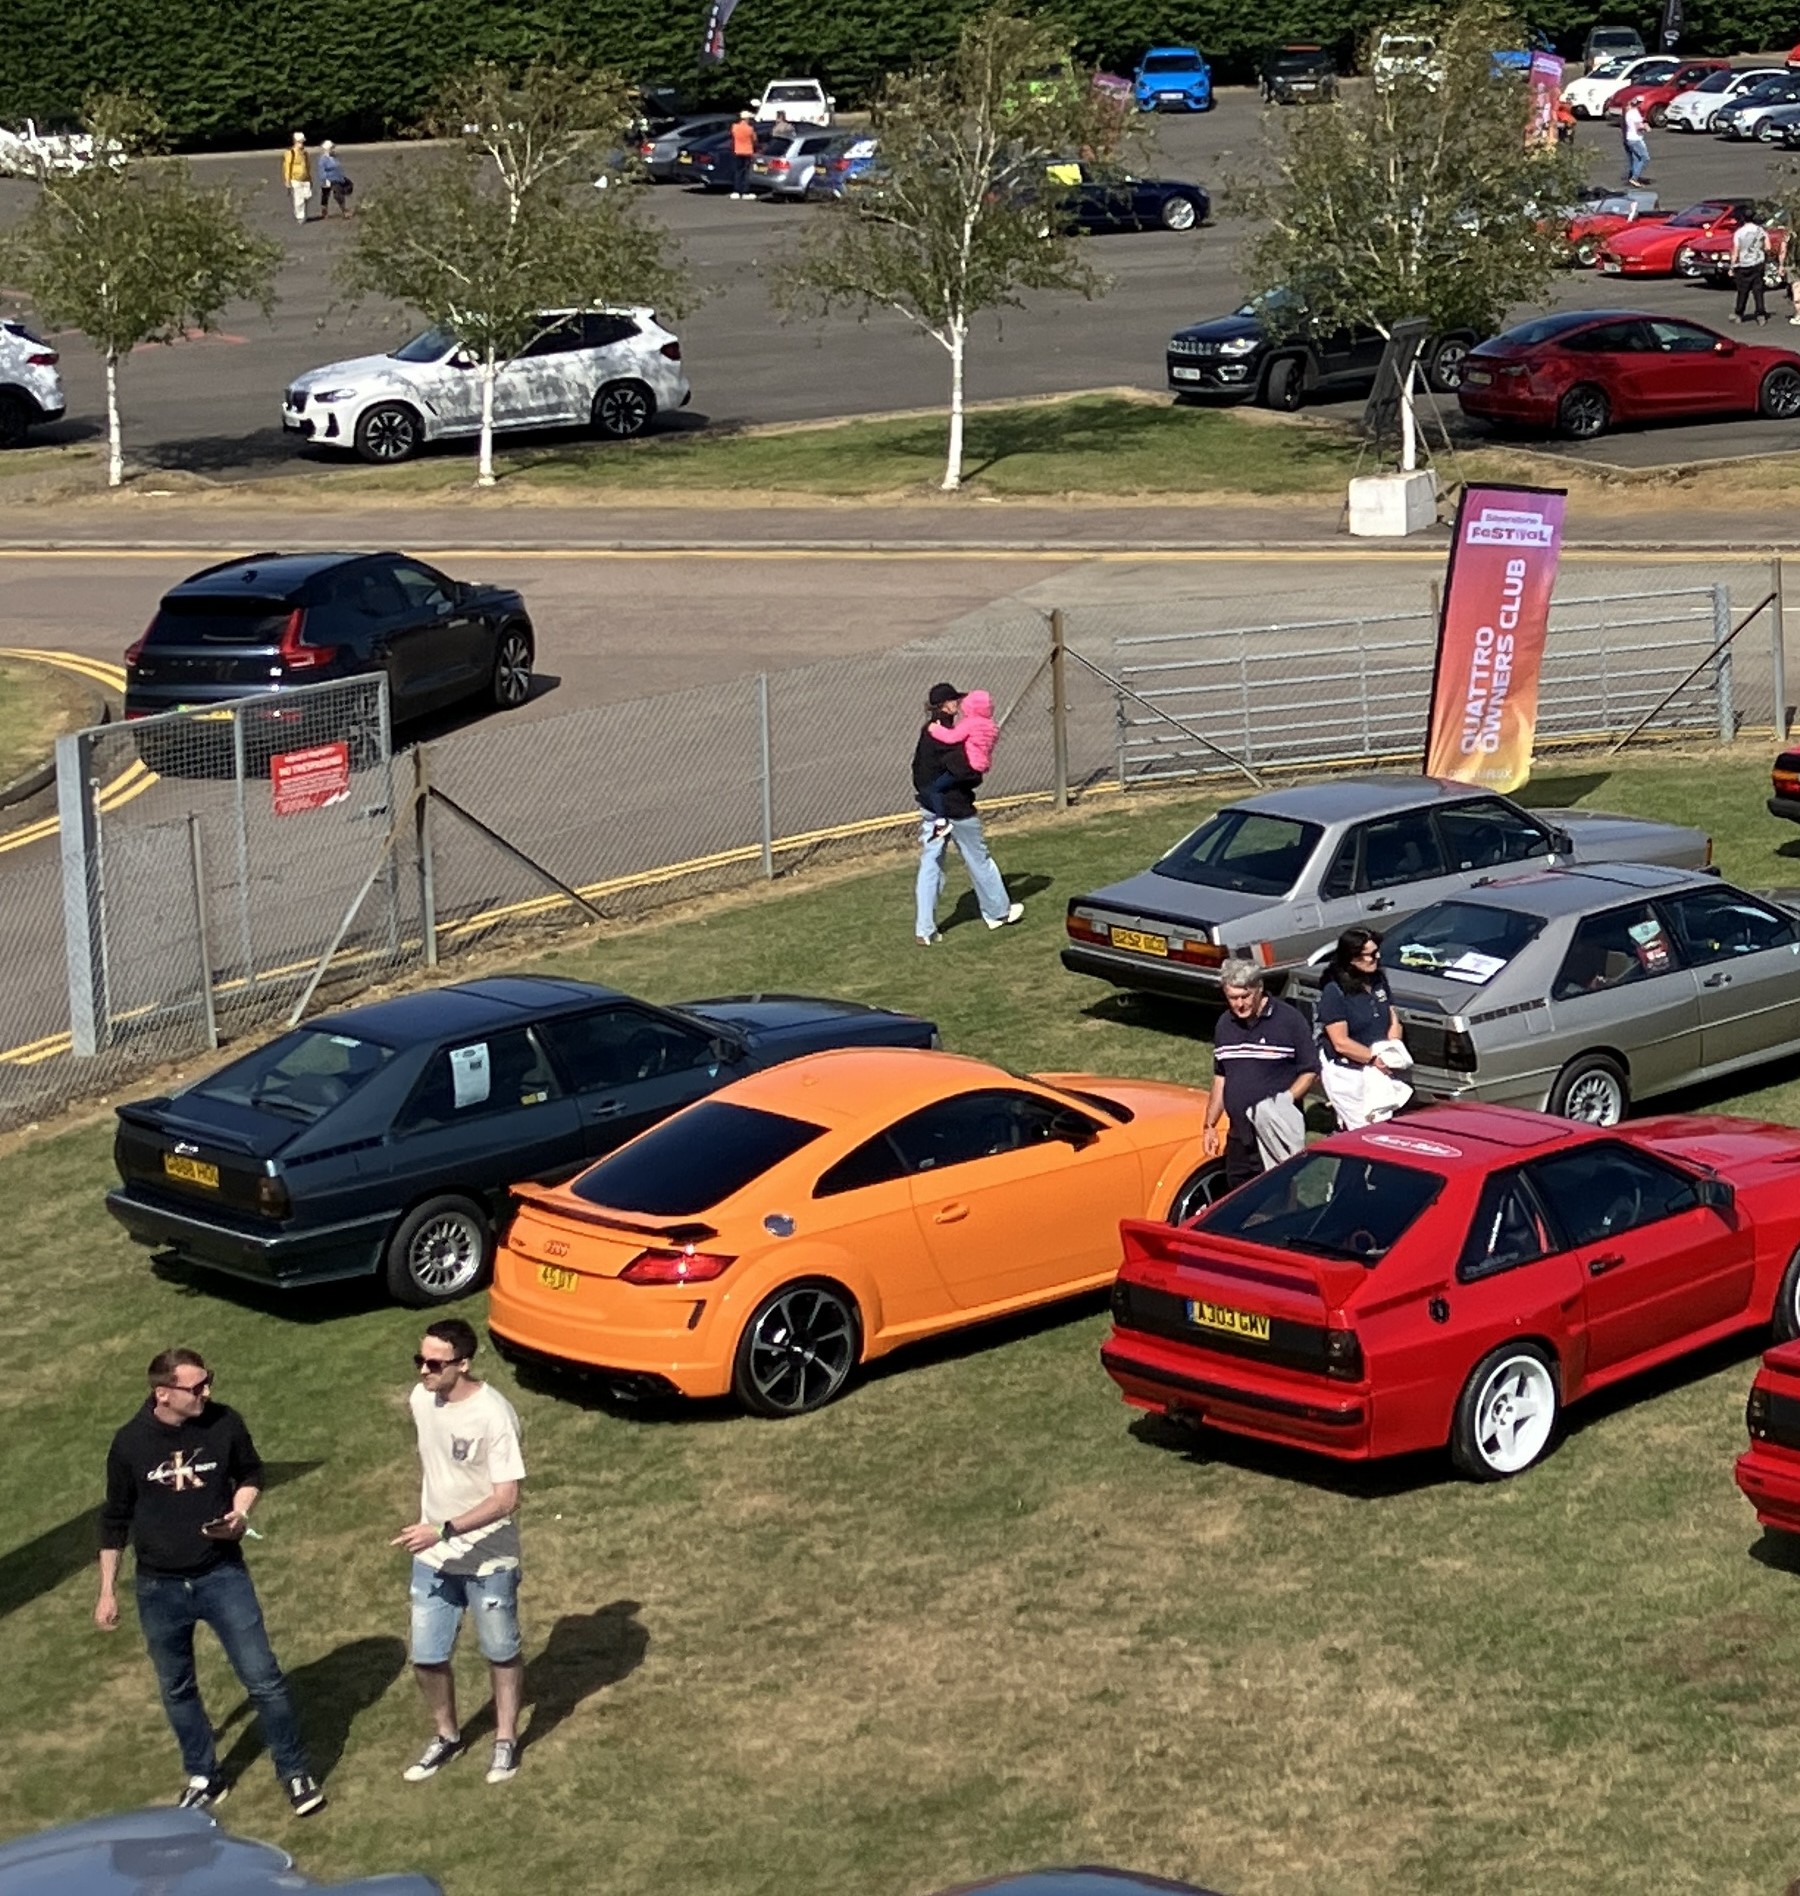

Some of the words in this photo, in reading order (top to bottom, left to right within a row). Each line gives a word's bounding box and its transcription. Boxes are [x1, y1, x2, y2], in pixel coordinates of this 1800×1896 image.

[1460, 626, 1495, 754] QUATTRO
[1481, 634, 1515, 753] OWNERS
[1499, 559, 1526, 630] CLUB
[1199, 1301, 1235, 1327] A303
